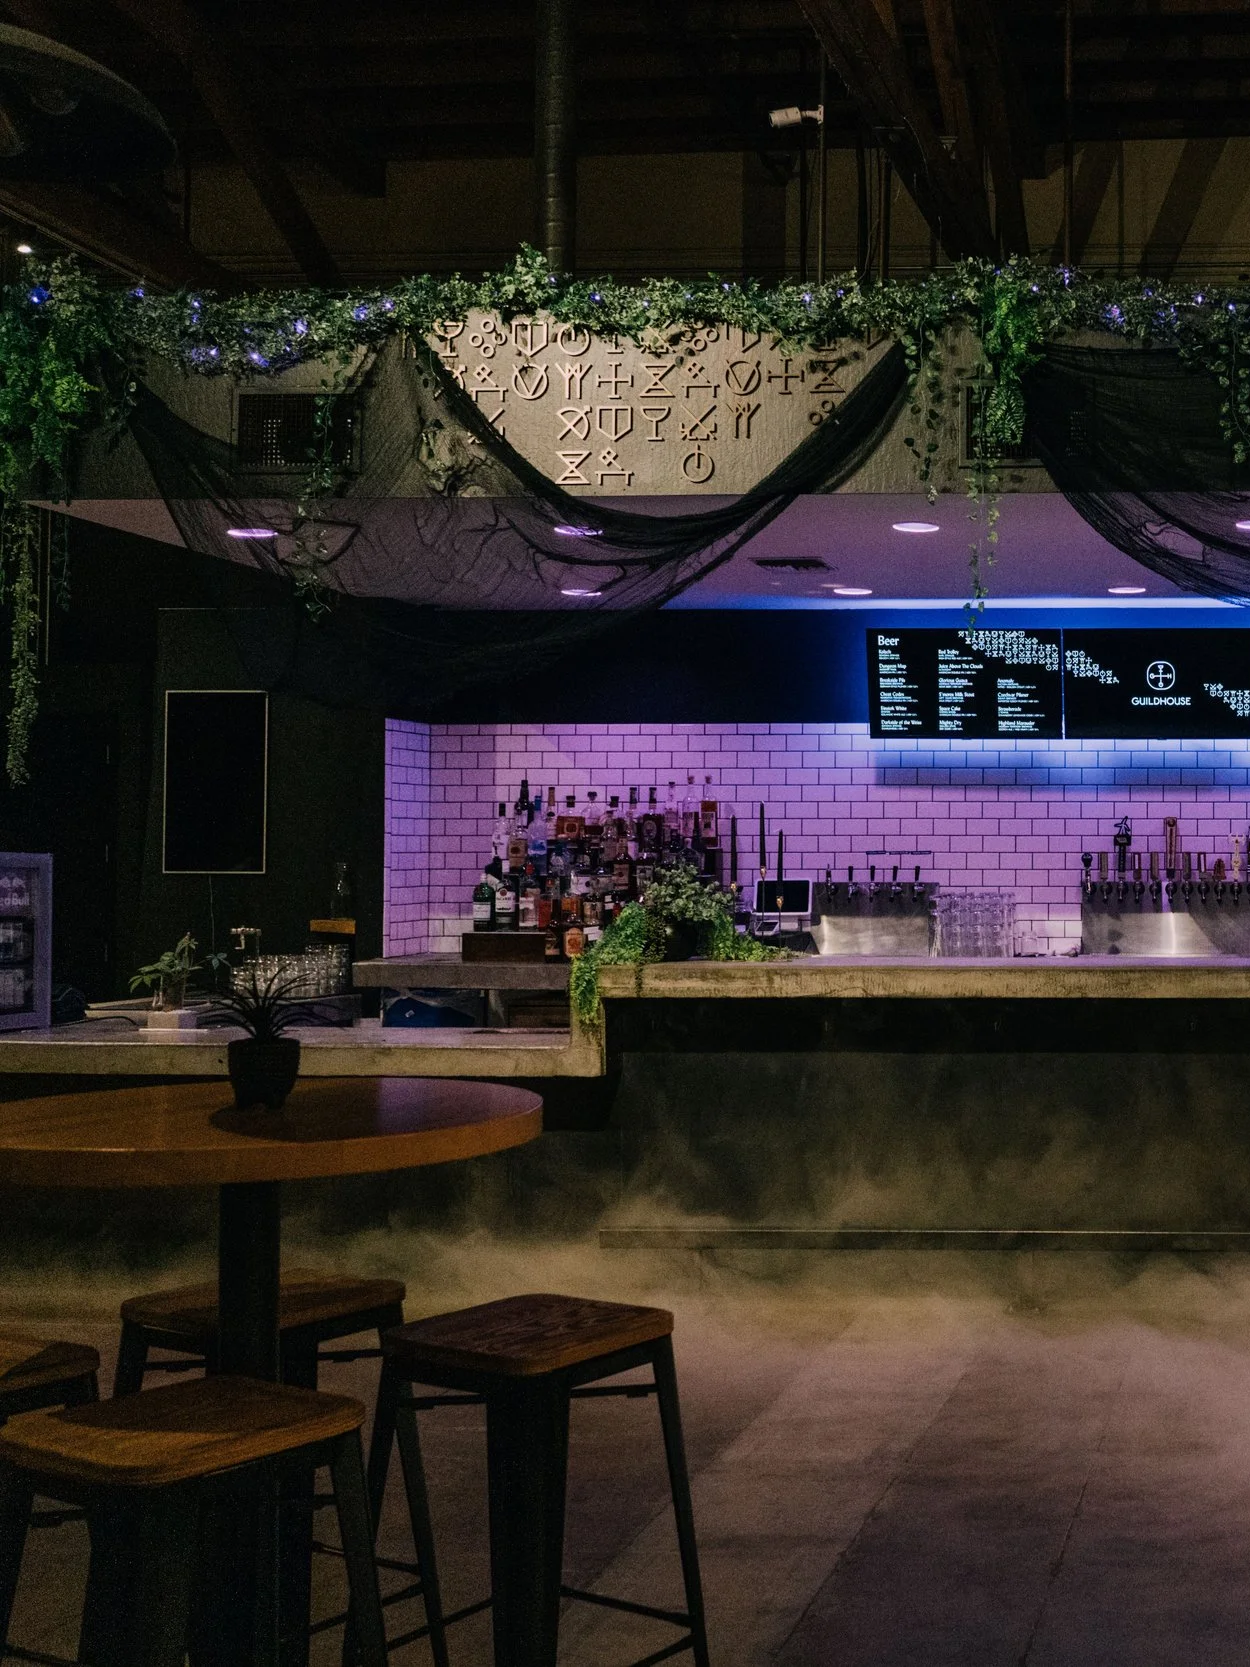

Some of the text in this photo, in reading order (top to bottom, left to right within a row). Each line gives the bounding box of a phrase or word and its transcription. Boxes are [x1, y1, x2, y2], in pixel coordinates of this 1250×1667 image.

[878, 635, 899, 646] Beer
[1131, 697, 1191, 705] GUILDHOUSE
[12, 893, 29, 905] Bull
